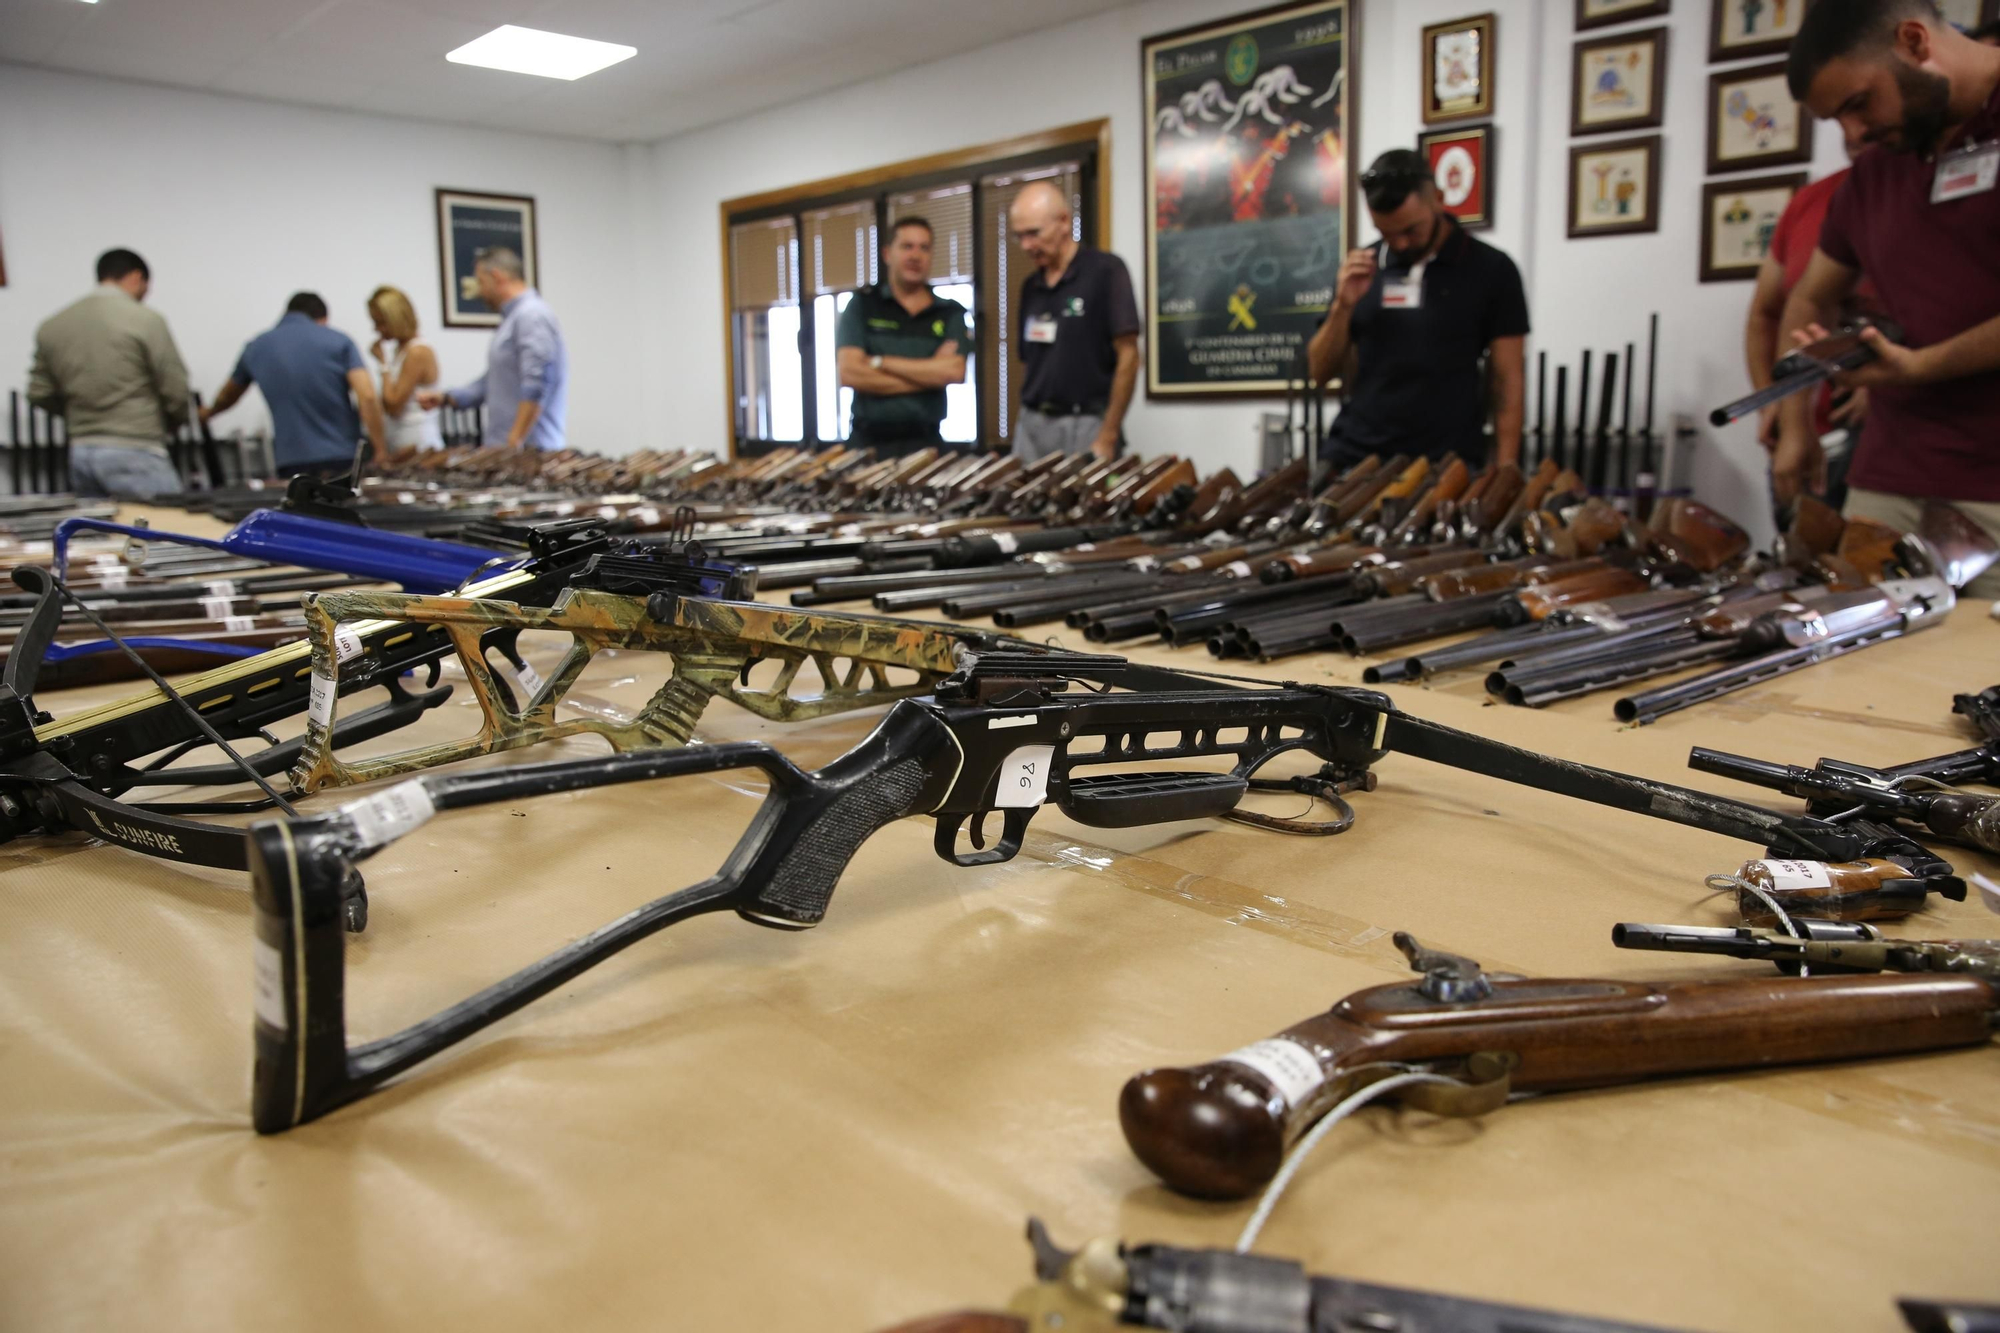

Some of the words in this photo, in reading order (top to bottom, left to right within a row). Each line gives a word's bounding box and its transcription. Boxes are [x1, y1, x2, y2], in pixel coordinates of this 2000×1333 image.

[1188, 349, 1254, 365] GUARDIA
[1255, 346, 1295, 362] CIVIL
[114, 821, 184, 855] SUNFIRE
